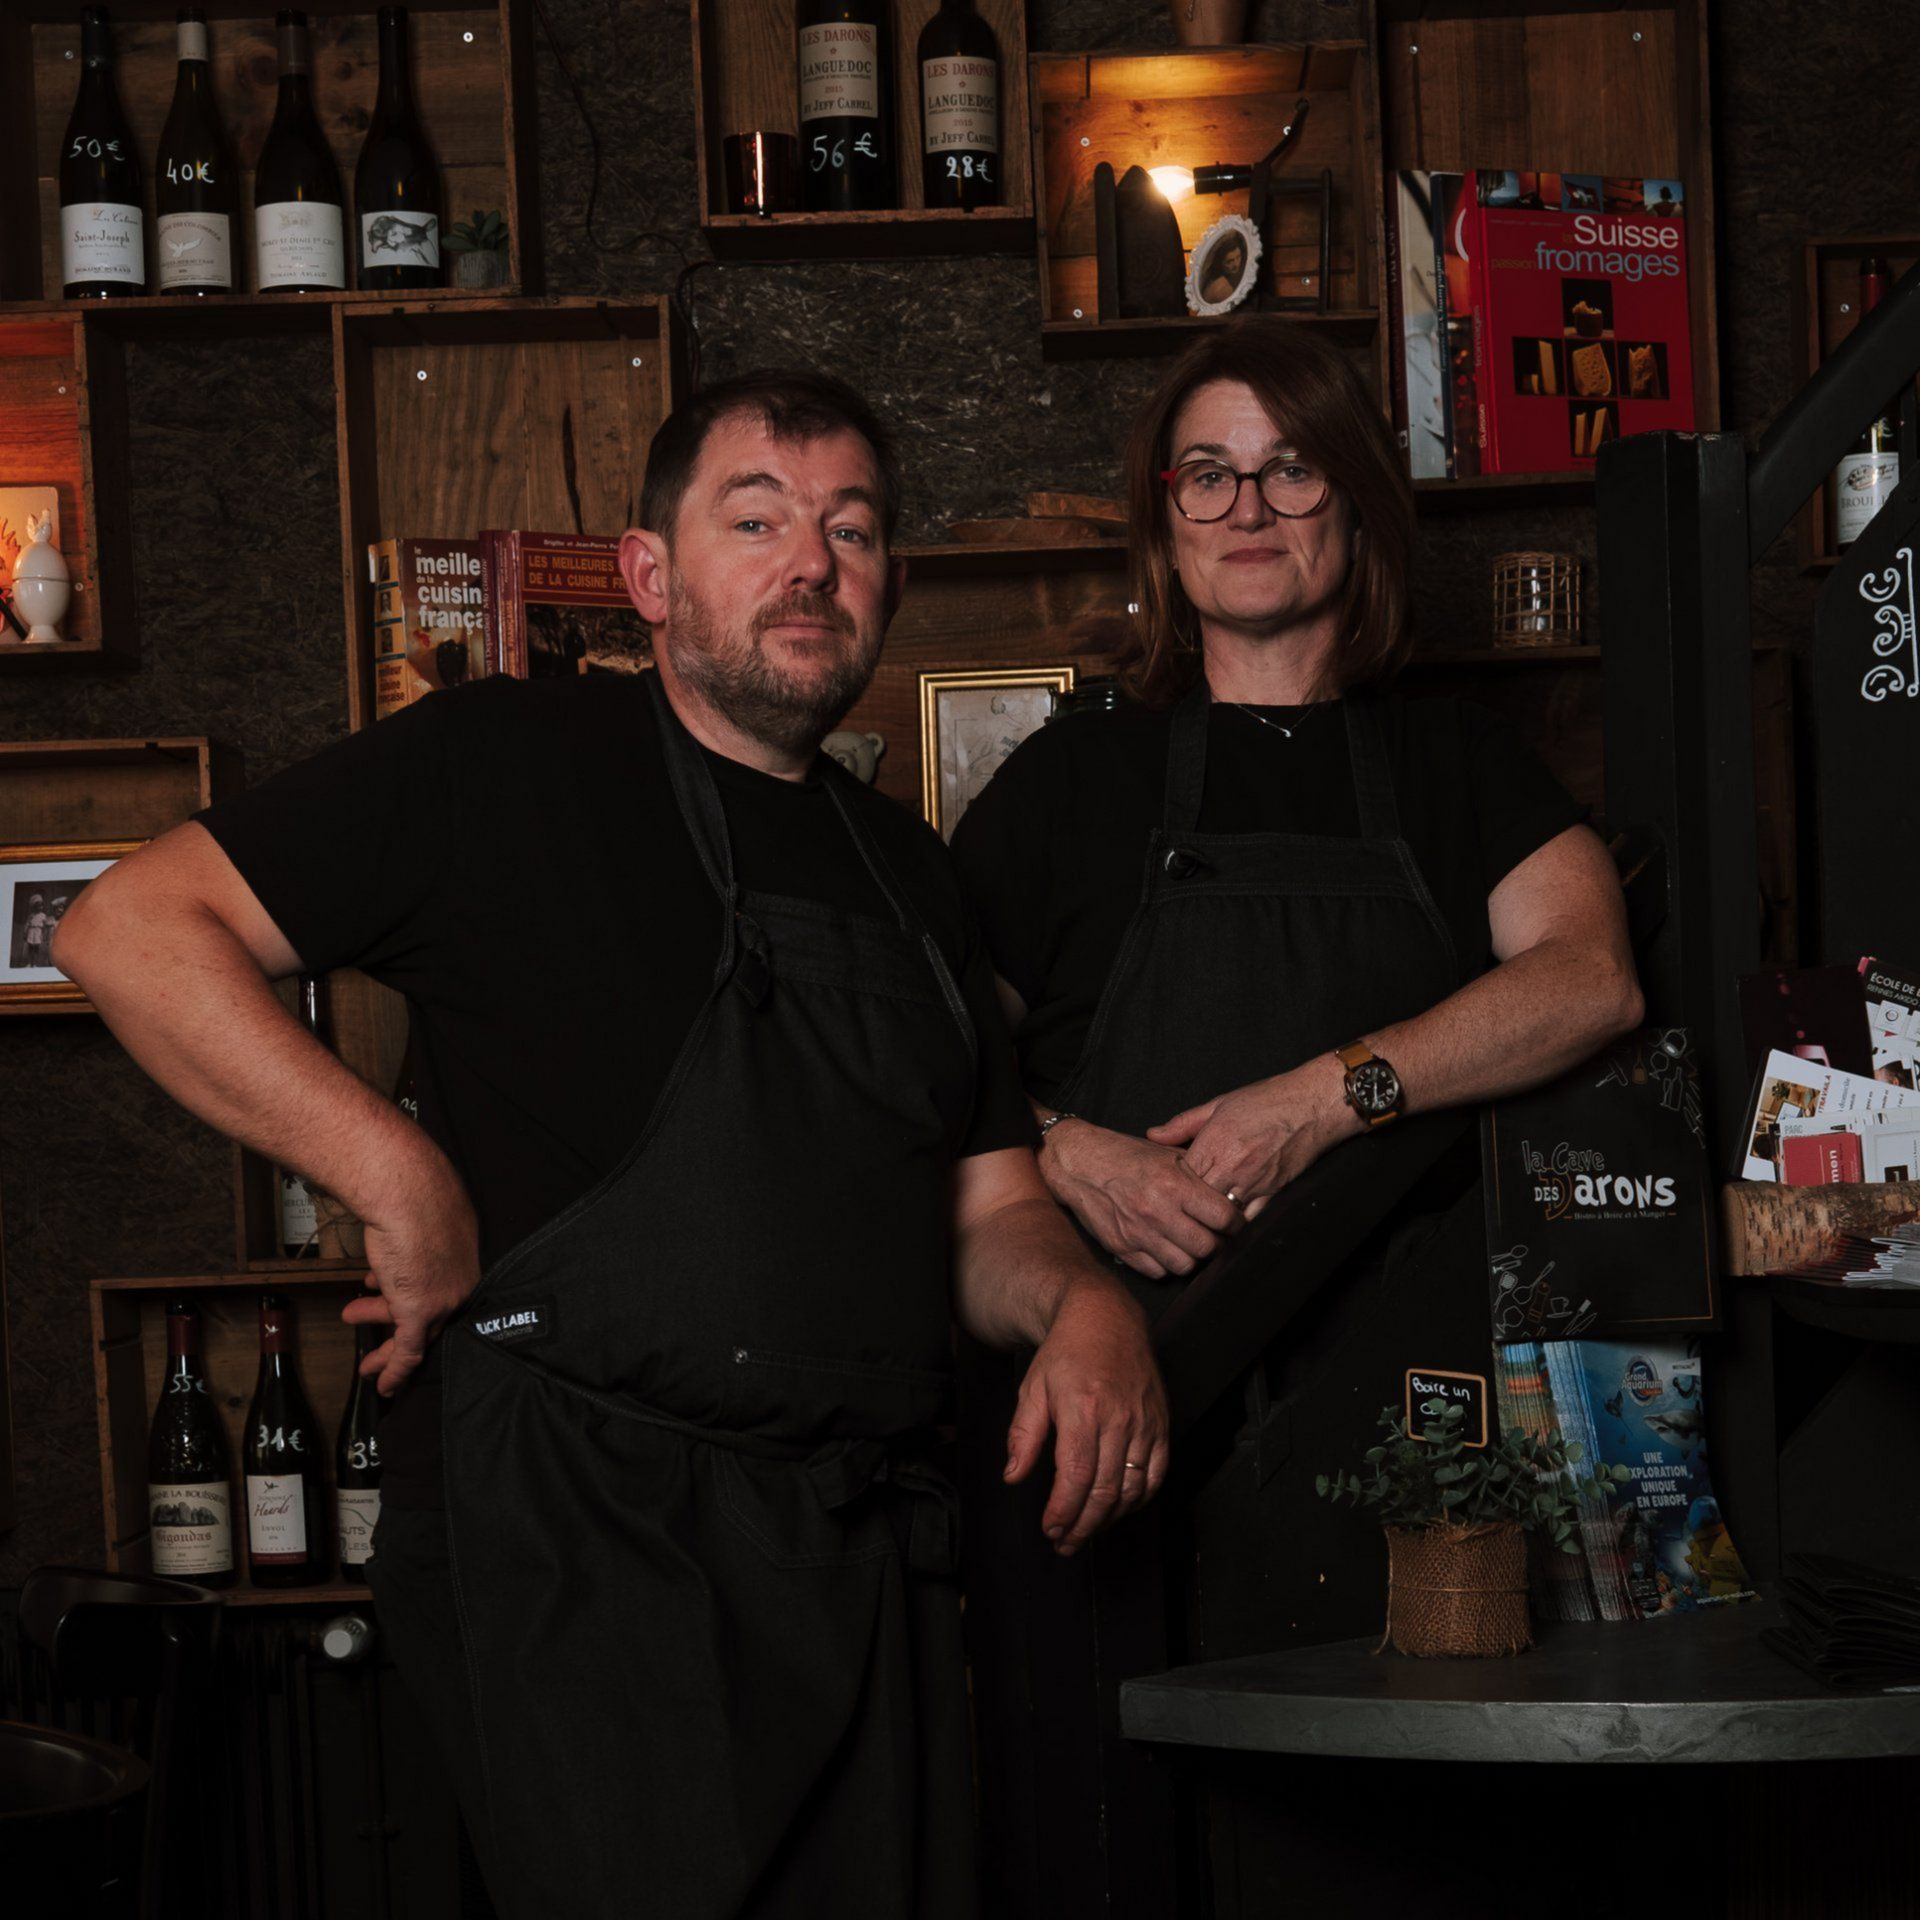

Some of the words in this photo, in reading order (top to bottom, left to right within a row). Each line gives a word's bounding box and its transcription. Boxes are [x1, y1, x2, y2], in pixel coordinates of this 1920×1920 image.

[802, 31, 820, 46] LES
[824, 29, 872, 43] DARONS
[803, 60, 872, 77] LANGUEDOC
[927, 64, 949, 78] LES
[953, 63, 994, 78] DARONS
[928, 94, 996, 109] LANGUEDOC
[1573, 215, 1680, 250] Suisse
[1535, 240, 1681, 283] fromages
[528, 555, 548, 570] LES
[552, 556, 615, 573] MEILLEURES
[416, 574, 426, 585] de
[427, 574, 435, 585] la
[529, 571, 544, 586] DE
[548, 573, 562, 587] LA
[567, 573, 607, 590] CUISINE
[417, 581, 483, 605] cuisin
[1870, 971, 1902, 990] ÉCOLE
[1902, 983, 1916, 995] DE
[1551, 1142, 1605, 1175] Cave
[1533, 1186, 1560, 1202] DES
[502, 1311, 539, 1329] LABEL
[1412, 1376, 1450, 1397] Boire
[1452, 1386, 1472, 1402] un
[1621, 1379, 1663, 1391] Aquarium
[1643, 1452, 1664, 1464] UNE
[1630, 1465, 1688, 1480] XPLORATION
[1641, 1480, 1677, 1494] UNIQUE
[1636, 1496, 1651, 1509] EN
[1651, 1494, 1688, 1508] EUROPE
